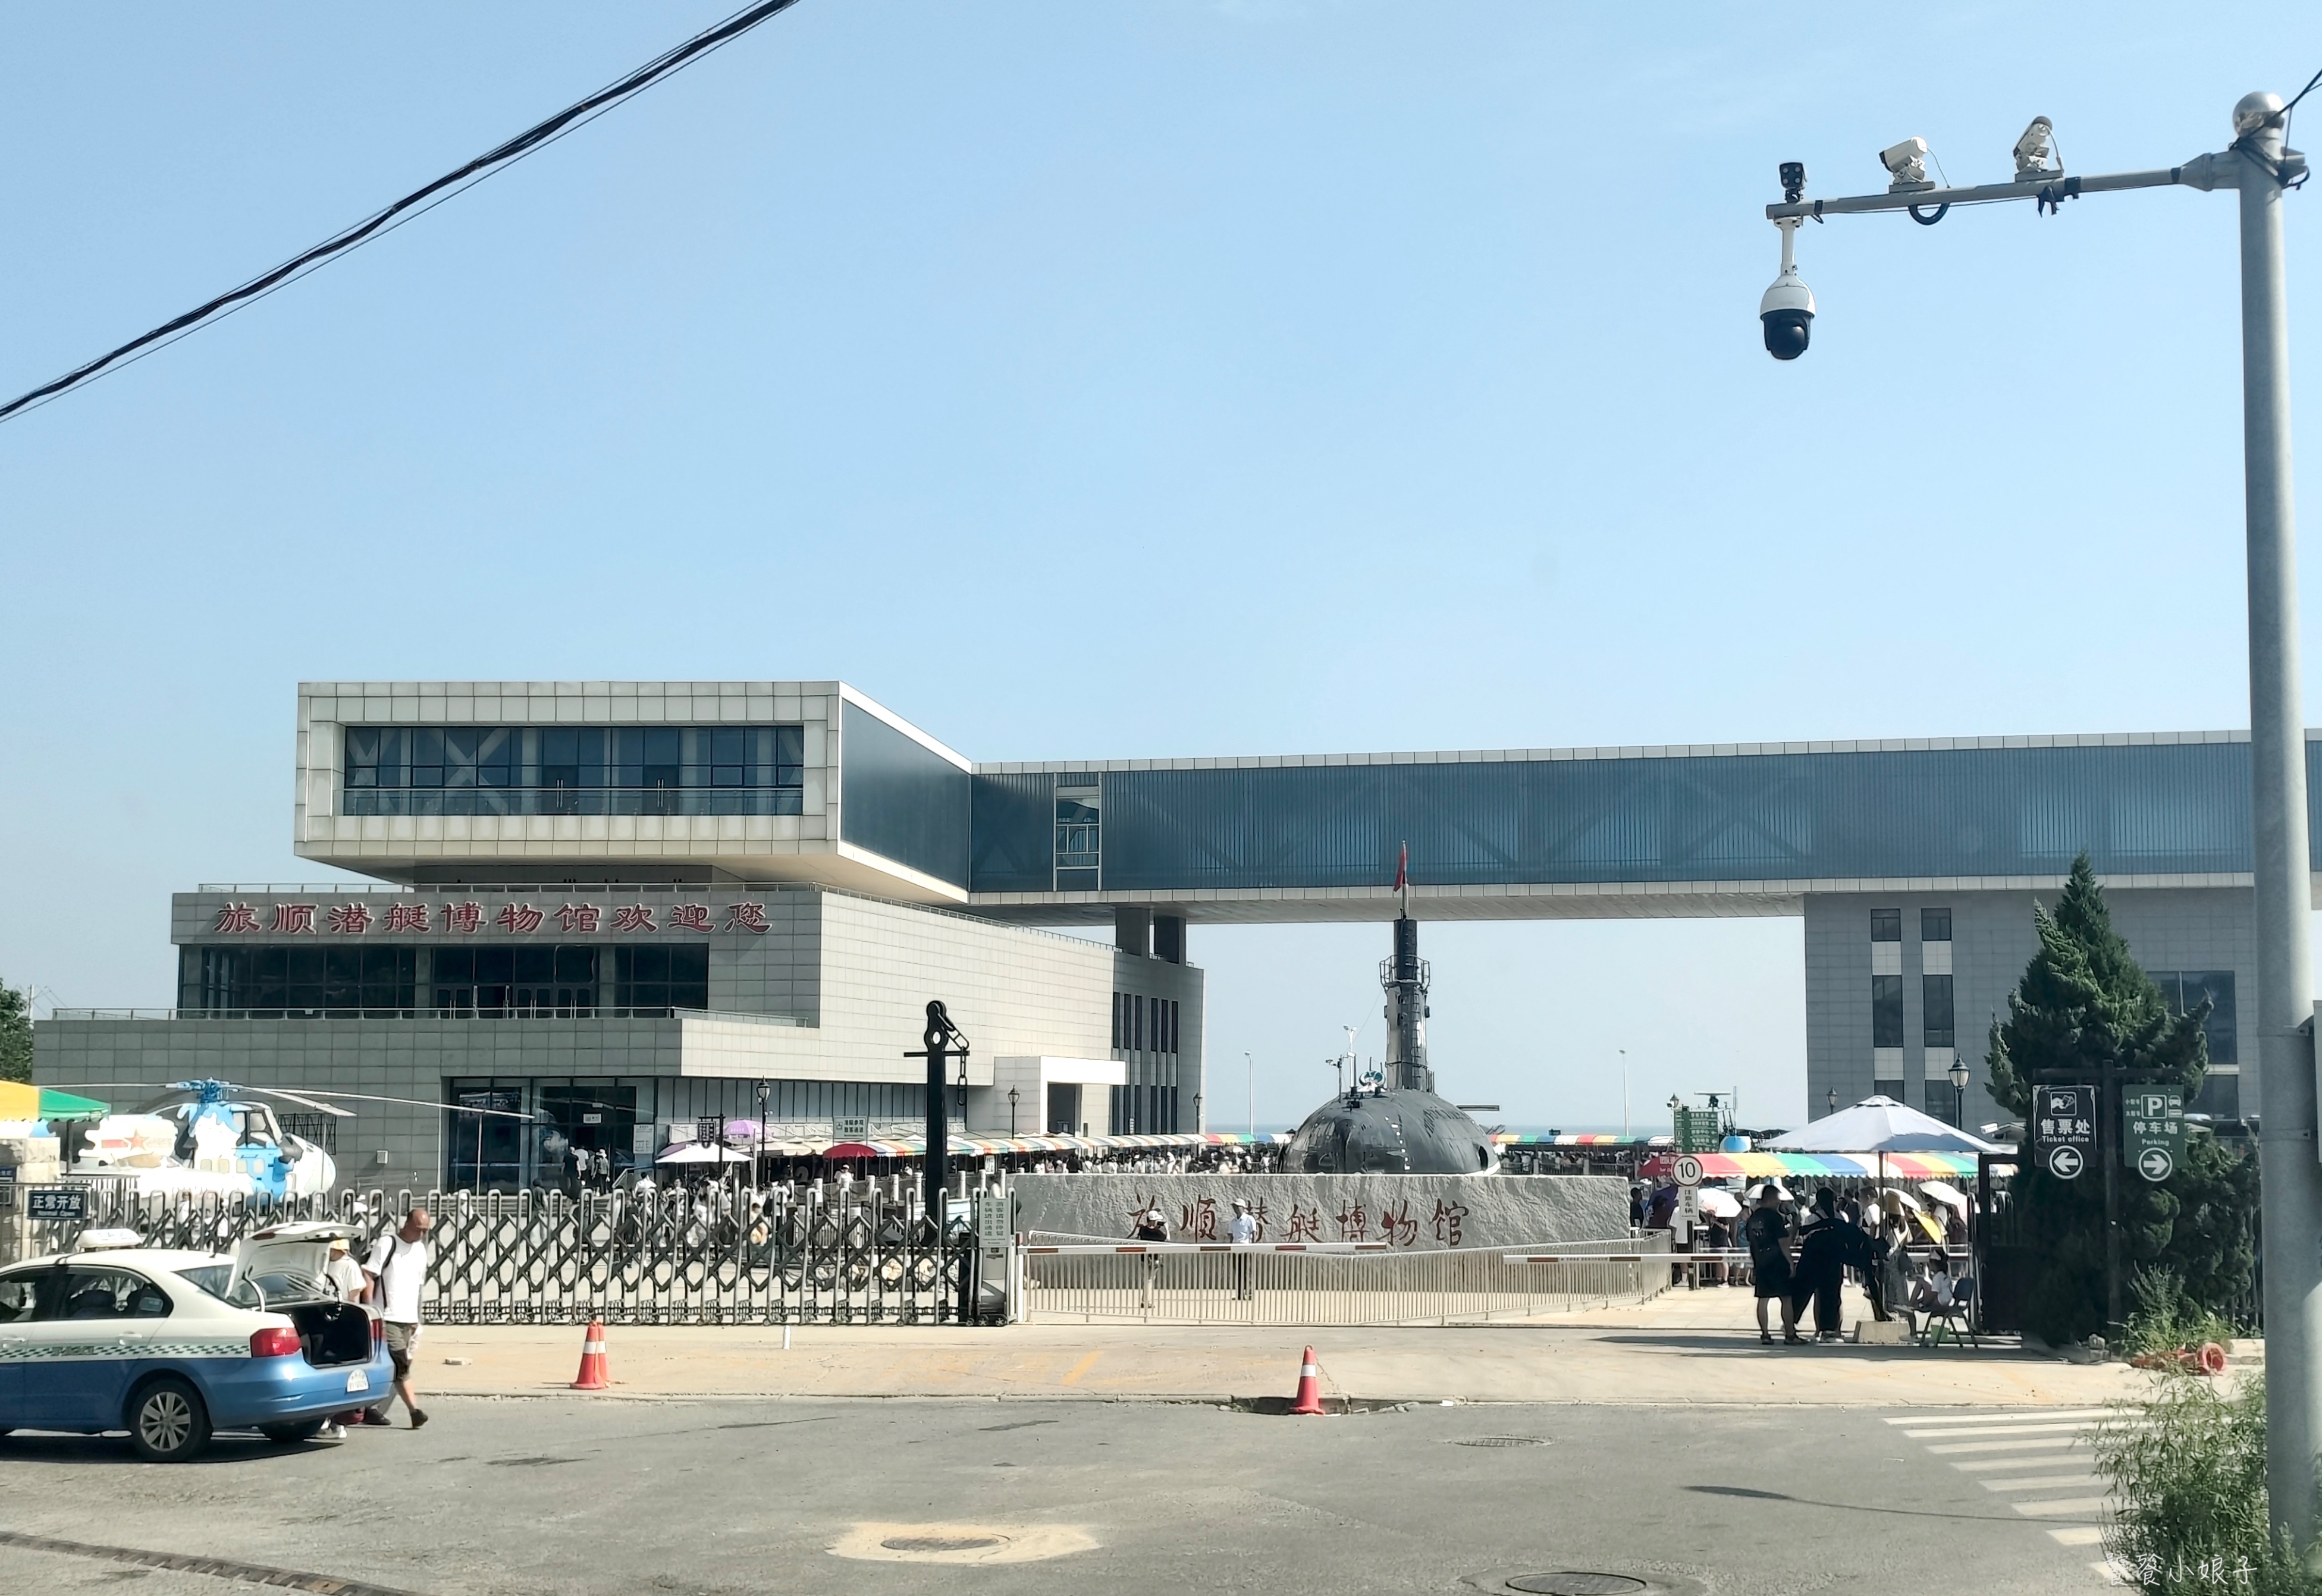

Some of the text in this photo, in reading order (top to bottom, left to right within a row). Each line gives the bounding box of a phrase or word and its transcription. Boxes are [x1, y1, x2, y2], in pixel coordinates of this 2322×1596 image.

[213, 901, 772, 934] 旅顺潜艇博物馆欢迎您
[2148, 1097, 2163, 1116] P
[2041, 1118, 2091, 1135] 售票处
[2133, 1121, 2177, 1135] 停车场
[2142, 1138, 2170, 1146] Parking
[1678, 1162, 1696, 1178] 10
[32, 1195, 81, 1209] 正常开放
